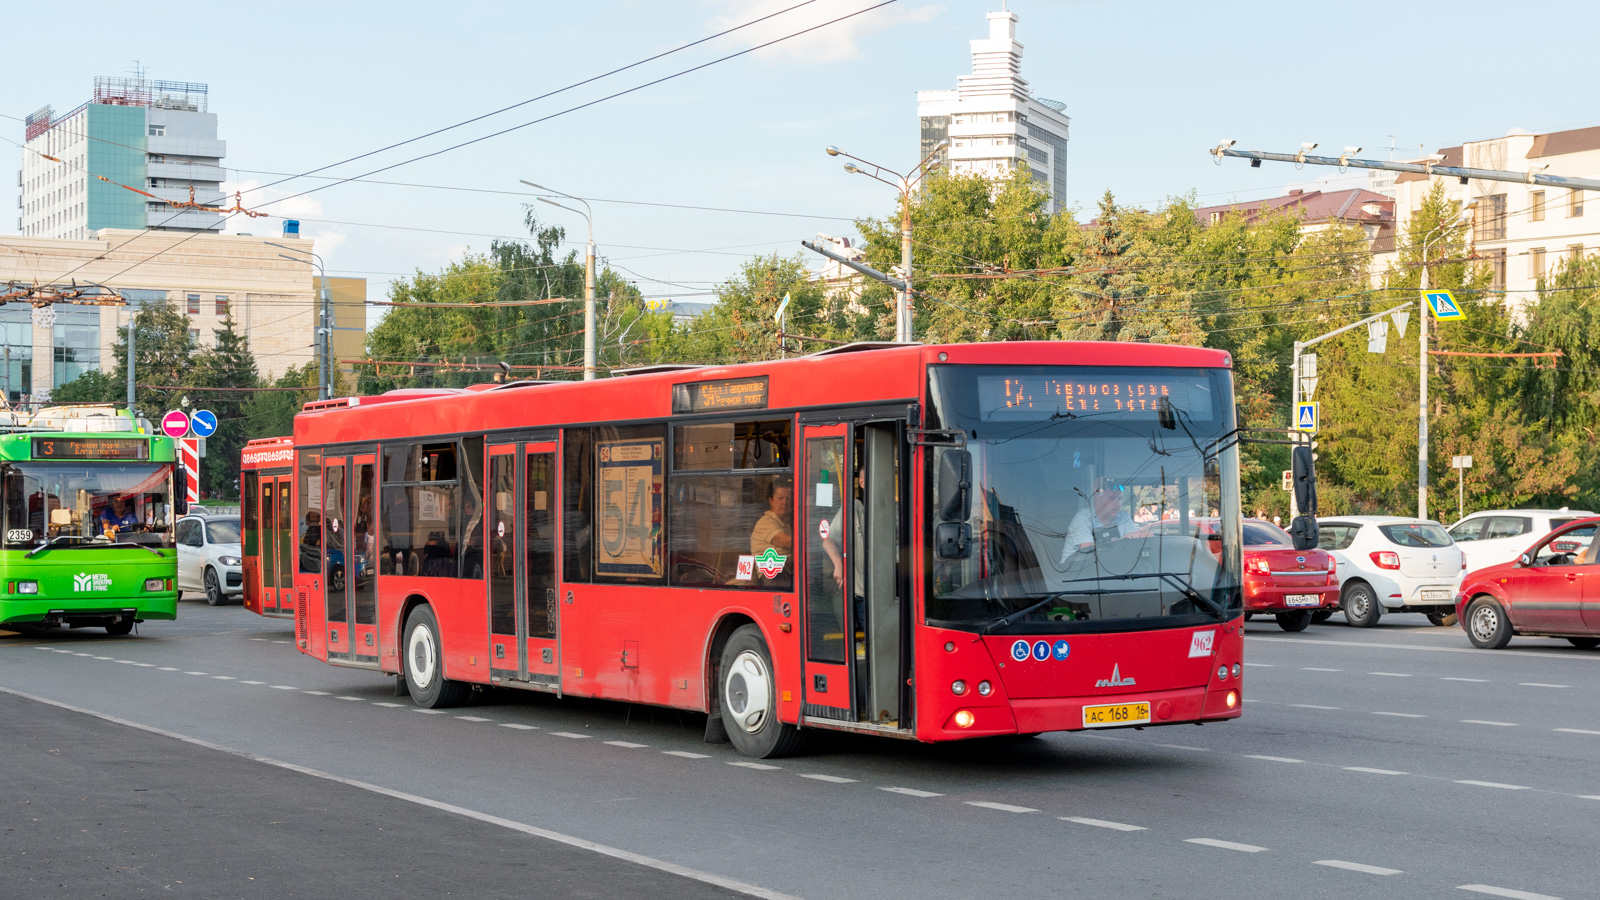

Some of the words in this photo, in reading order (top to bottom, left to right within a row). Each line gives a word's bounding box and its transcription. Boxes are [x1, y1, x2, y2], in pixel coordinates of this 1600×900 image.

[43, 441, 54, 455] 3
[604, 479, 650, 552] 54
[9, 530, 31, 540] 2359
[738, 561, 751, 575] 962
[1193, 635, 1211, 652] 962
[1091, 711, 1104, 722] АС
[1108, 707, 1128, 721] 168
[1135, 705, 1146, 715] 16
